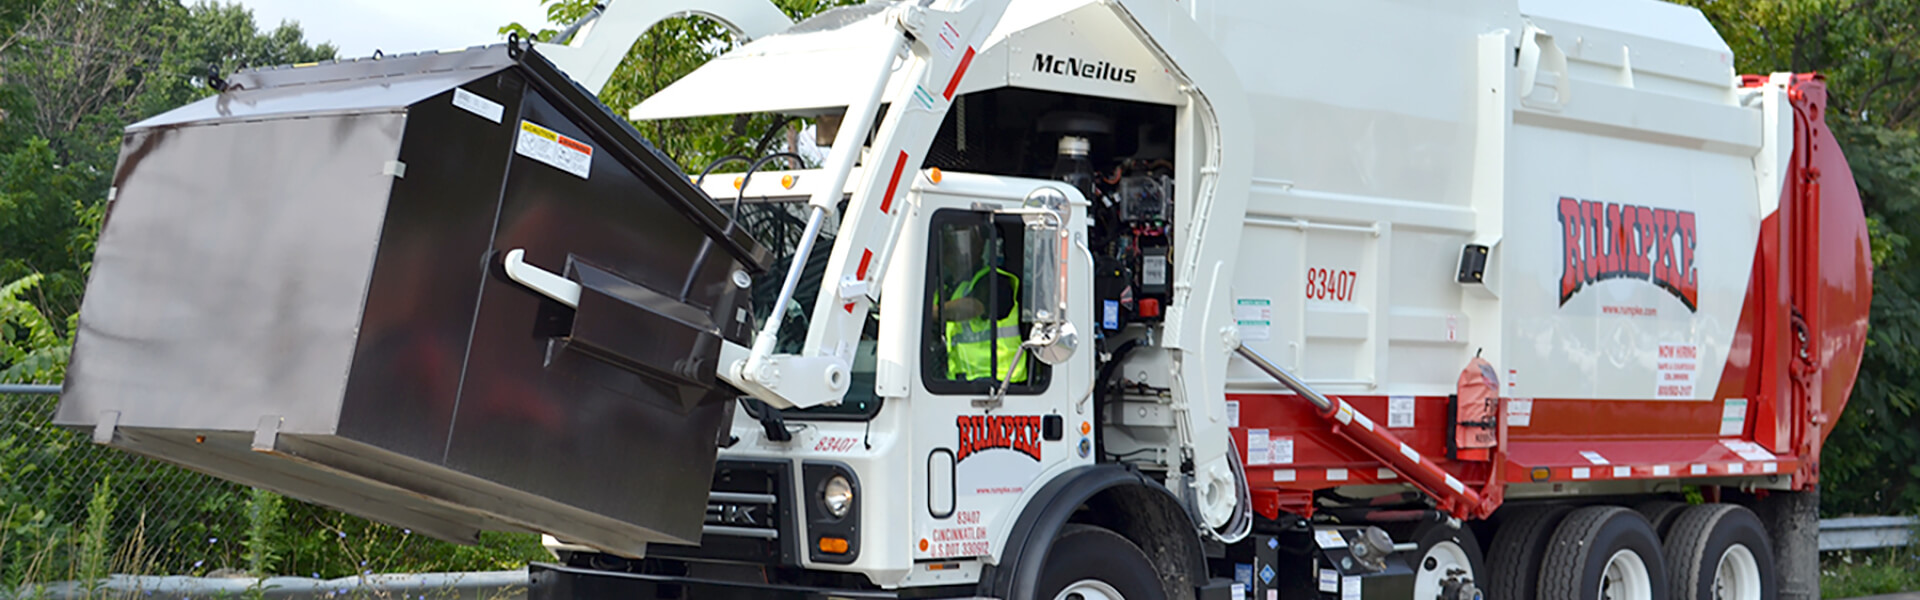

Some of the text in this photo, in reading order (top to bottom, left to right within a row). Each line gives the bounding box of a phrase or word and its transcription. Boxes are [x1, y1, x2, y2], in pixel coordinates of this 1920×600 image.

[1032, 53, 1137, 83] McNeilus
[1558, 197, 1698, 313] RUMPKE
[1306, 267, 1357, 302] 83407
[1602, 305, 1657, 318] www.rumpke.com
[814, 436, 858, 452] 83407
[957, 415, 1042, 463] RUMPKE
[976, 486, 1023, 496] www.rumpke.com
[957, 510, 981, 525] 83407
